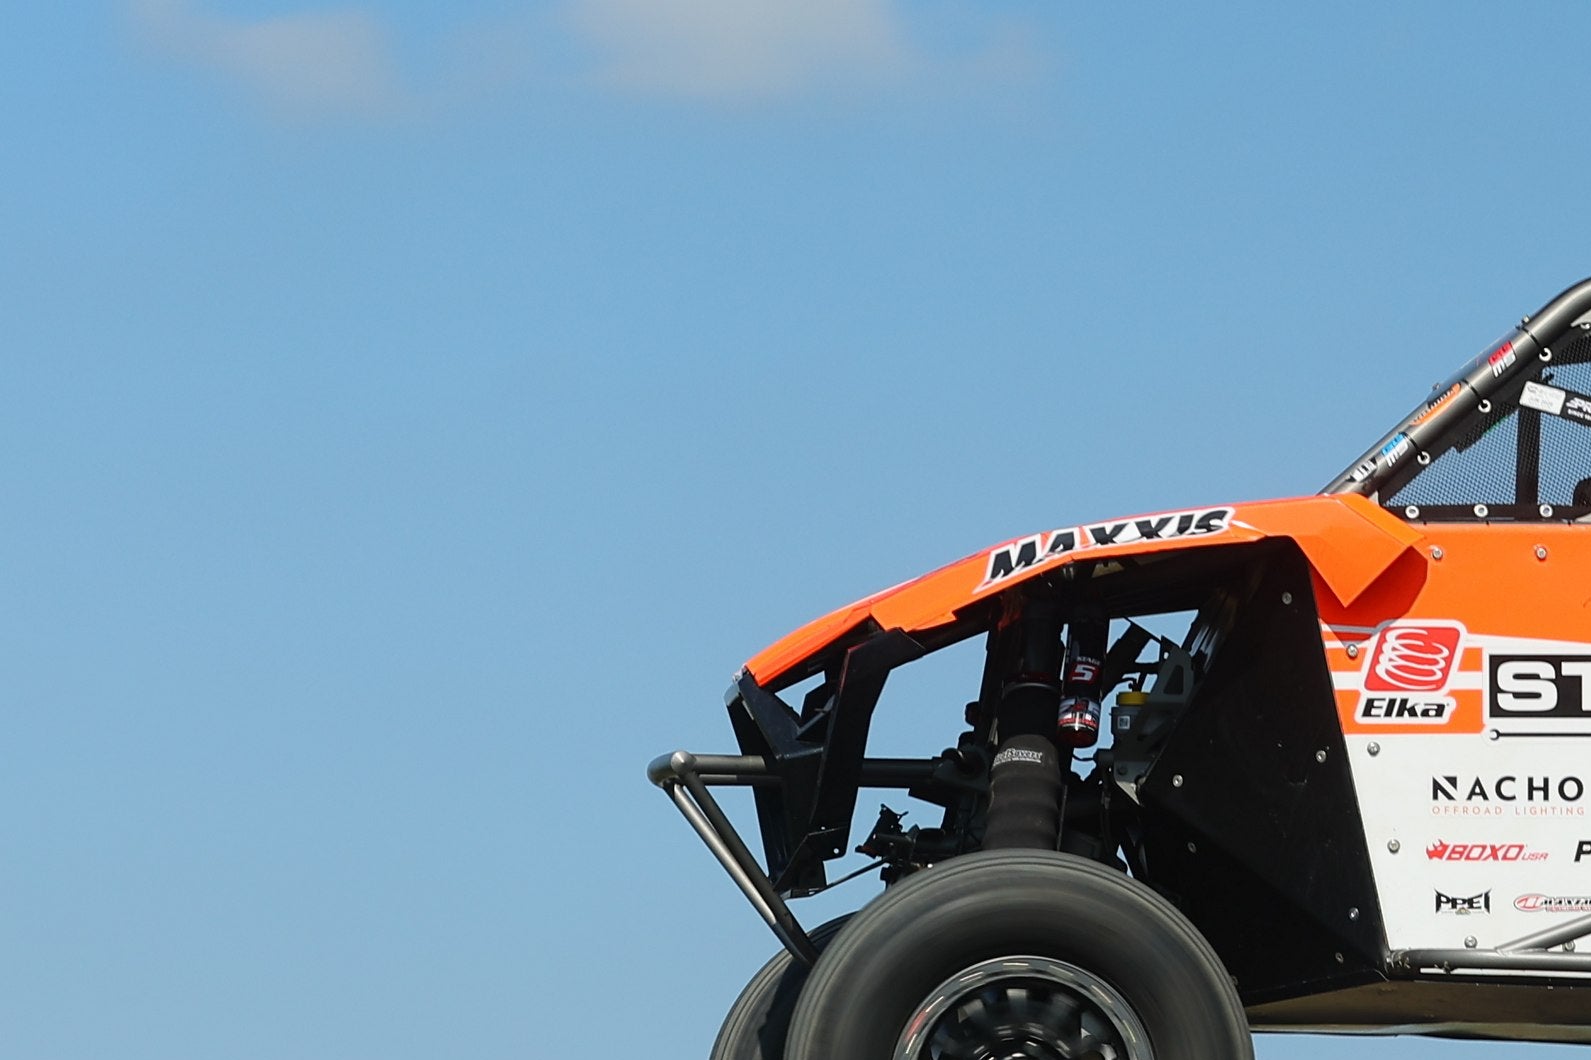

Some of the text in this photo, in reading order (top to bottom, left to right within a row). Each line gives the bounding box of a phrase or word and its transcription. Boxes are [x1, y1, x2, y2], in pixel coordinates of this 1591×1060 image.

[990, 509, 1228, 580] MAXXIS
[1071, 665, 1096, 681] 5
[1361, 698, 1446, 718] Elka
[1432, 776, 1584, 801] NACHO
[1432, 806, 1585, 816] OFFROAD LIGHTING
[1445, 845, 1525, 861] BOXO
